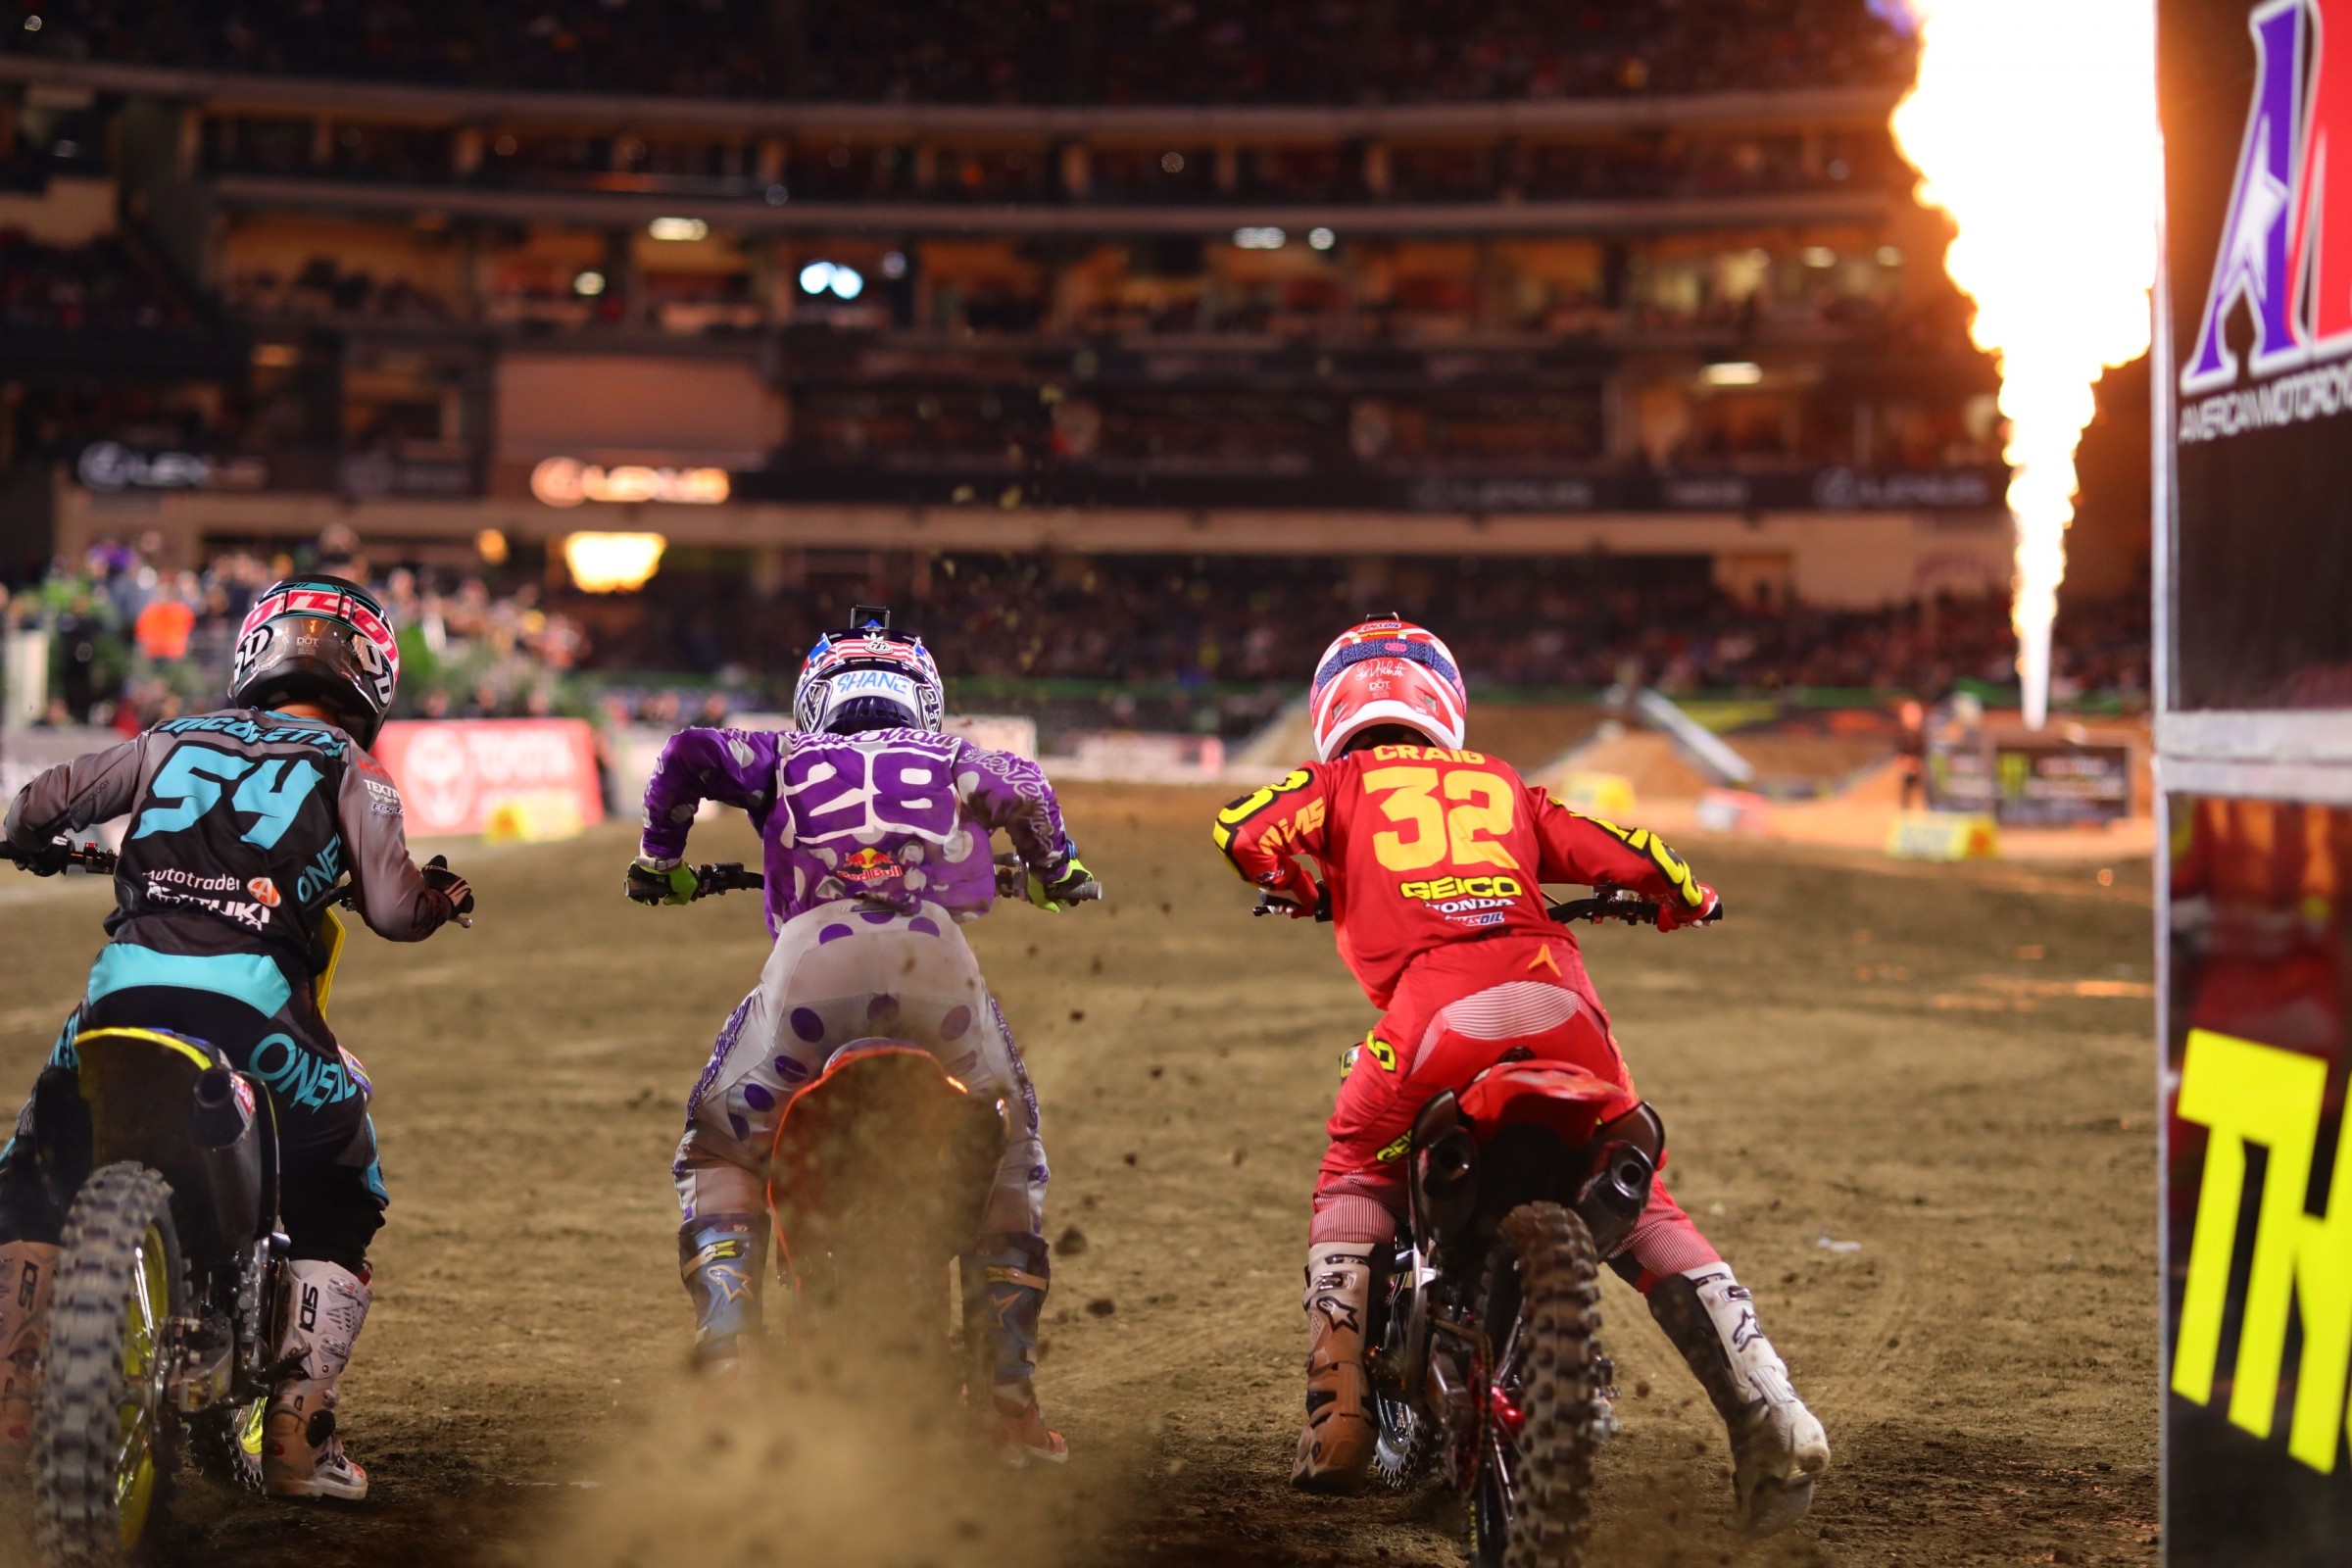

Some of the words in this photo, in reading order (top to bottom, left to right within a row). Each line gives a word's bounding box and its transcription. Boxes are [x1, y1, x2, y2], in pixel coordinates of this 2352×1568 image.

[297, 636, 319, 646] DOT
[837, 672, 911, 695] SHANE
[1373, 745, 1487, 765] CRAIG
[130, 745, 324, 850] 54
[782, 747, 956, 840] 28
[1362, 766, 1520, 871] 32
[1401, 876, 1523, 900] GEICO
